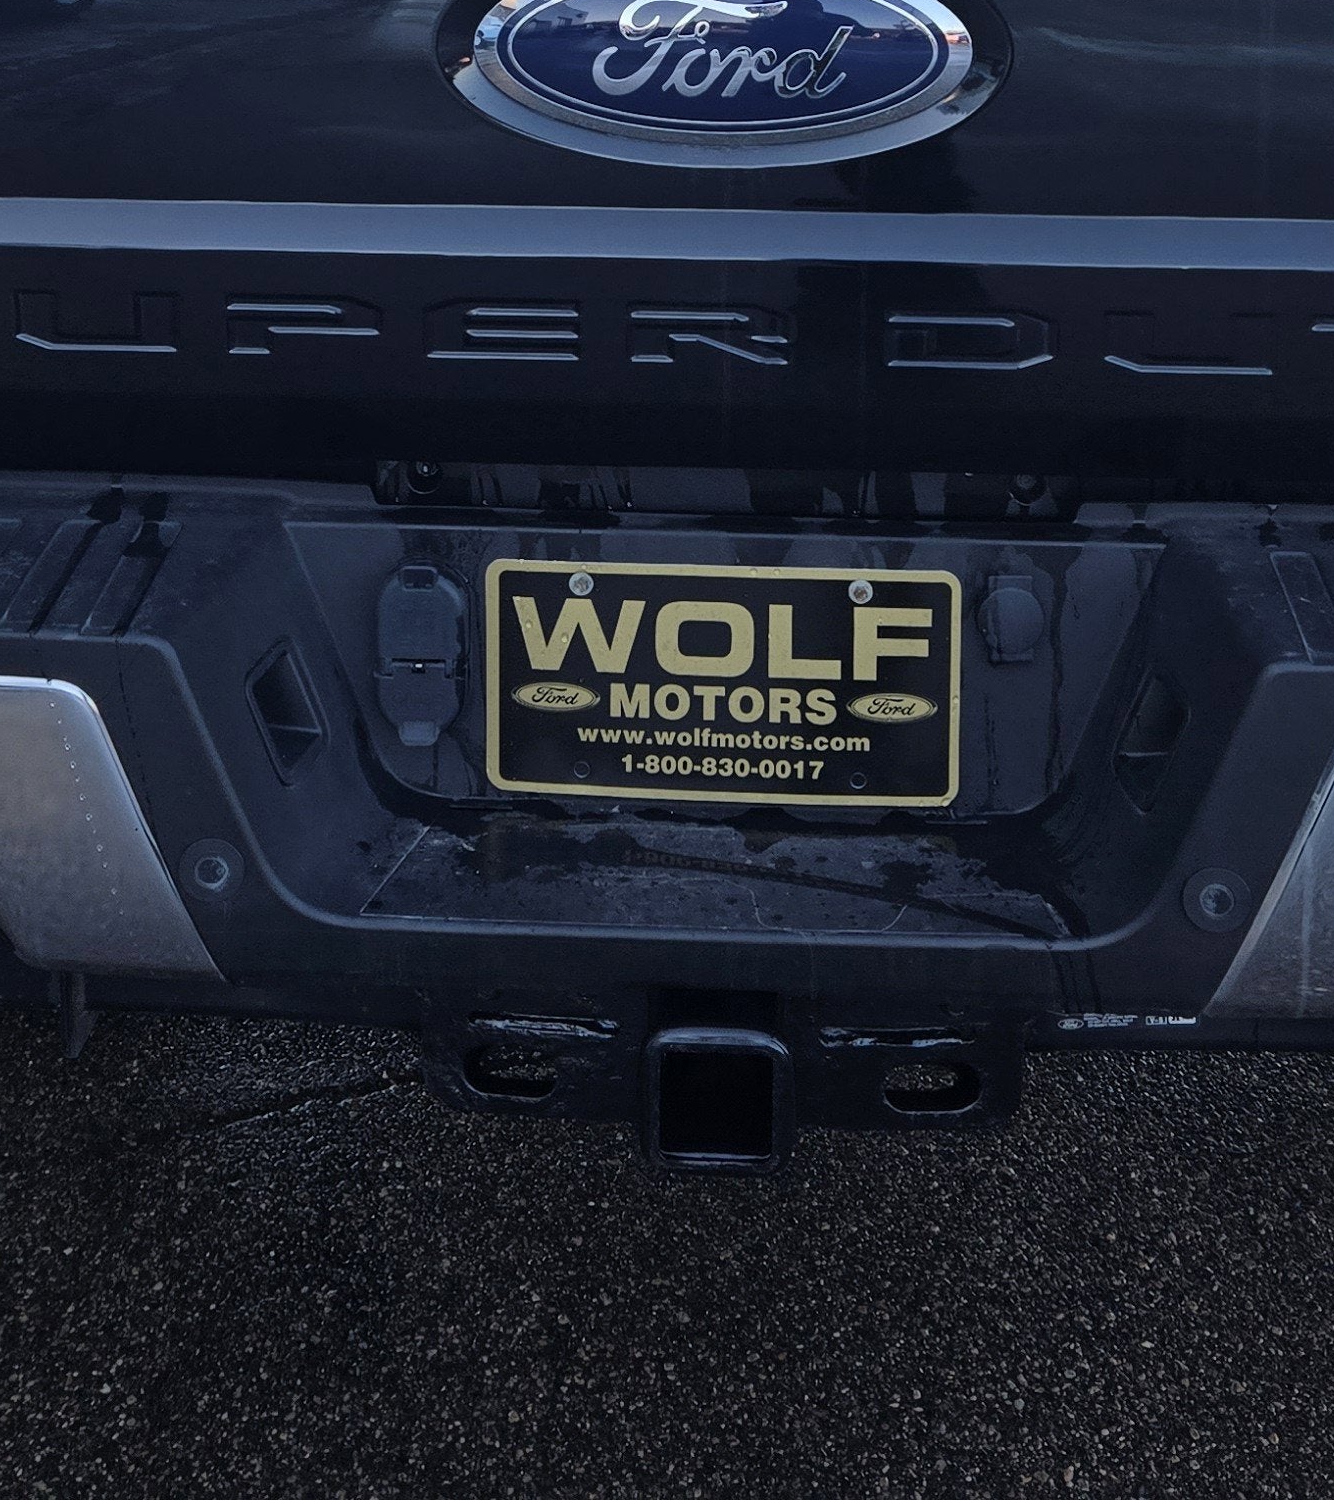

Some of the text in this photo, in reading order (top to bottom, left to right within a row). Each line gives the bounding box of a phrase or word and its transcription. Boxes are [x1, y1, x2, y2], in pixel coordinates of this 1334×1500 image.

[512, 596, 933, 682] WOLF
[531, 685, 579, 707] Ford
[609, 682, 838, 726] MOTORS
[866, 696, 916, 718] Ford
[577, 727, 871, 753] www.wolfmotors.com
[621, 754, 825, 781] 1-800-830-0017
